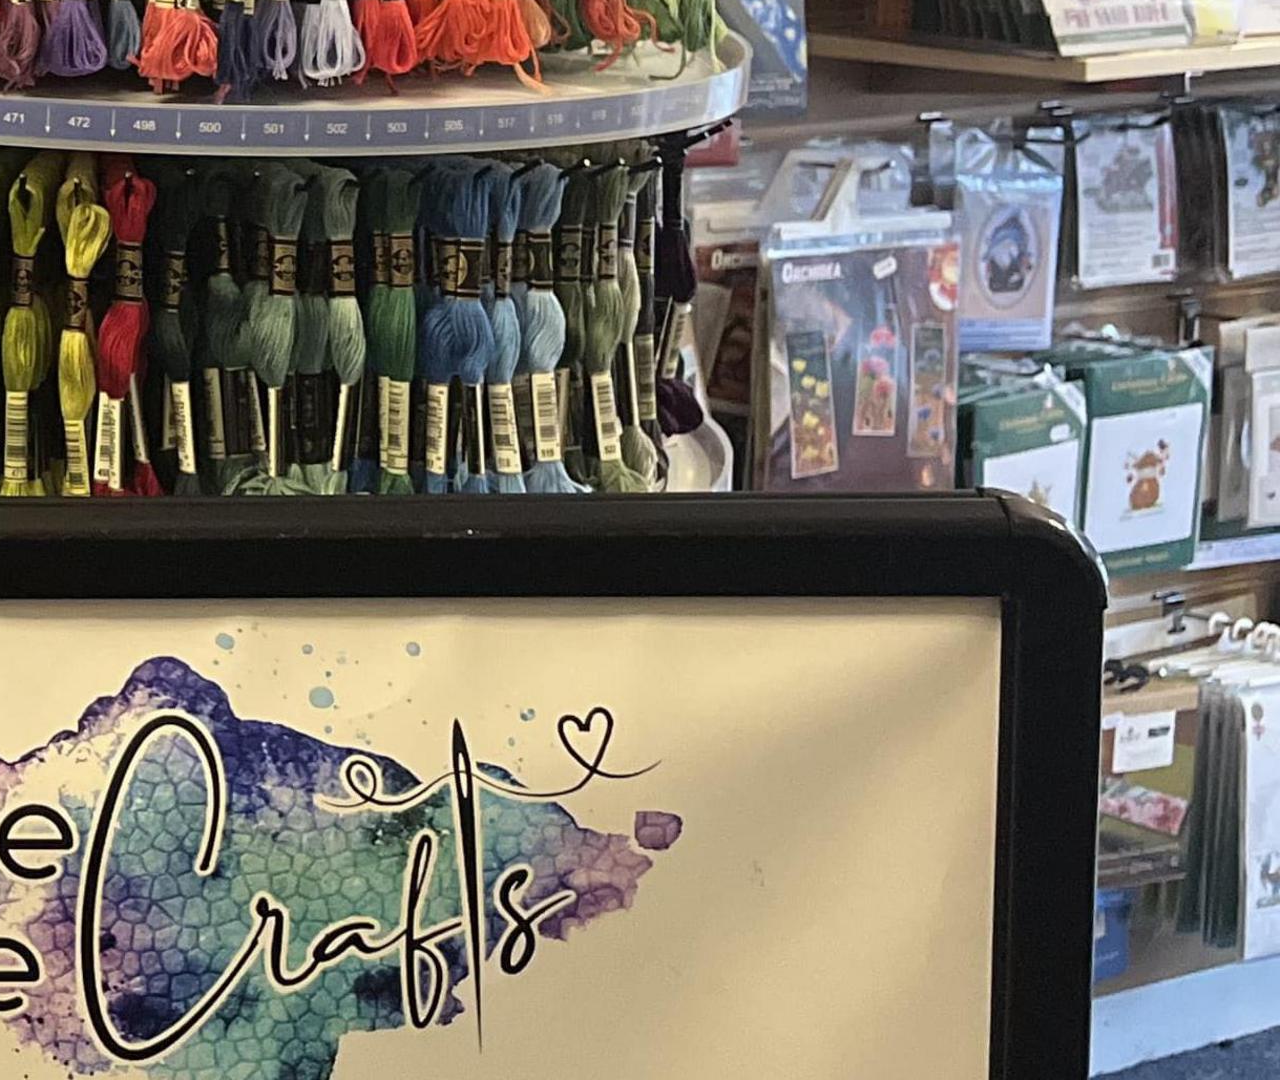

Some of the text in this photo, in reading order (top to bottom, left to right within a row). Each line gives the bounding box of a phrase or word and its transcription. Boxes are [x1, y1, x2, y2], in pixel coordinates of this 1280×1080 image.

[3, 112, 25, 124] 471
[67, 116, 91, 128] 472
[132, 119, 156, 131] 498
[199, 121, 222, 133] 500
[263, 122, 285, 134] 501
[326, 122, 348, 135] 502
[387, 122, 408, 133] 503
[81, 713, 577, 1062] Crafts
